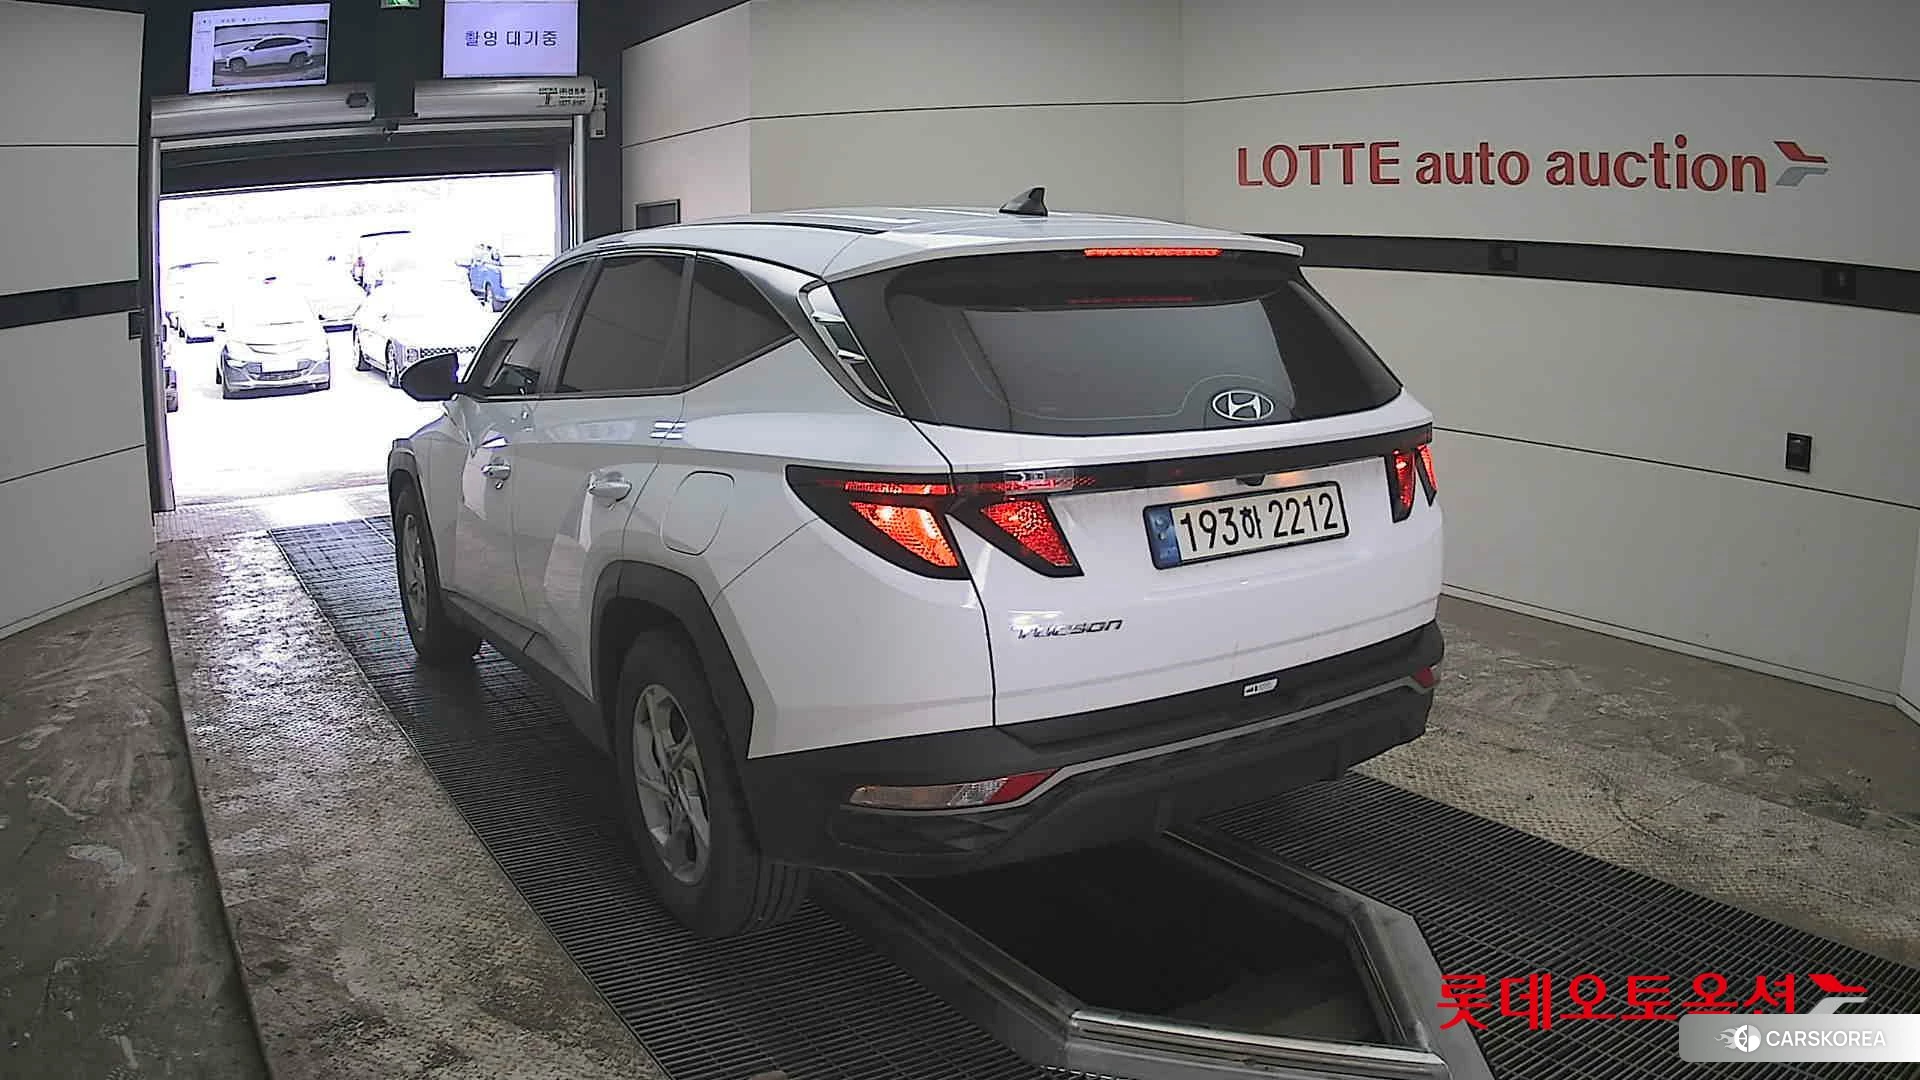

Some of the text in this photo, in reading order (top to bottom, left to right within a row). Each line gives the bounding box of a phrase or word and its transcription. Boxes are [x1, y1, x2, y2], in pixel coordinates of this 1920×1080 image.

[506, 30, 557, 47] 대기중
[1237, 134, 1767, 193] LOTTE auto auction
[1180, 492, 1338, 552] 193하 2212
